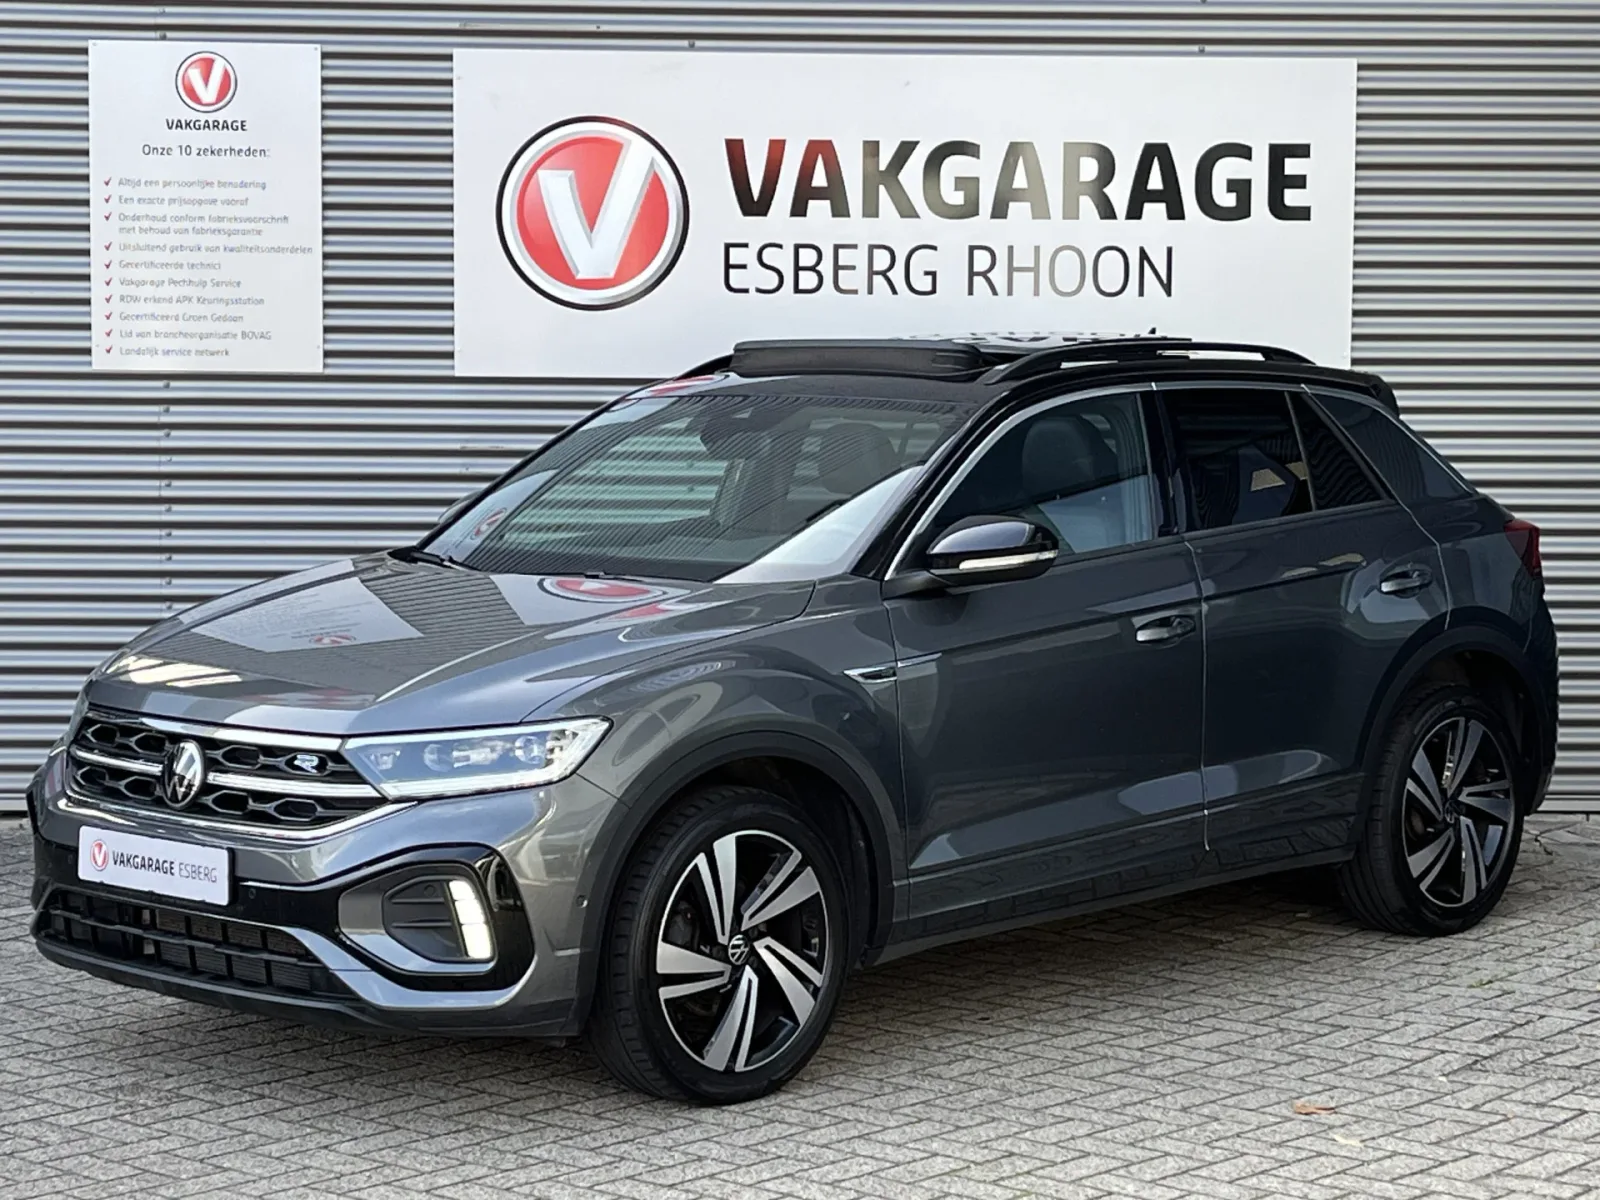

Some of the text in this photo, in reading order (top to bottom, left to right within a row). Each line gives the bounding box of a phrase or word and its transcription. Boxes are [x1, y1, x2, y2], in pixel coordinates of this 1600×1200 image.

[166, 118, 248, 131] VAKGARAGE
[142, 144, 271, 158] Onze 10 zekerheden:
[118, 177, 142, 189] Altijd
[144, 179, 160, 187] een
[162, 179, 215, 190] persoonlijke
[724, 138, 1312, 221] VAKGARAGE
[118, 195, 135, 204] Een
[137, 196, 166, 205] exacte
[220, 197, 249, 206] vooraf
[118, 212, 167, 222] Onderhoud
[170, 213, 206, 223] conform
[119, 226, 136, 234] met
[139, 226, 171, 235] behoud
[119, 242, 167, 252] Uitsluitend
[169, 243, 202, 254] gebruik
[204, 245, 220, 253] van
[119, 259, 221, 271] Gecertificeerde technici
[723, 243, 1174, 298] ESBERG RHOON
[119, 277, 242, 289] Vakgarage Pechhulp Service
[119, 294, 265, 307] RDW erkend APK Keuringsstation
[119, 311, 244, 322] Gecertificeerd Groen Gedaan
[119, 329, 133, 339] Lid
[135, 331, 152, 339] van
[241, 330, 272, 341] BOVAG
[162, 347, 193, 357] service
[195, 347, 230, 358] netwerk
[112, 851, 175, 877] VAKGARAGE
[178, 862, 218, 884] ESBERG
